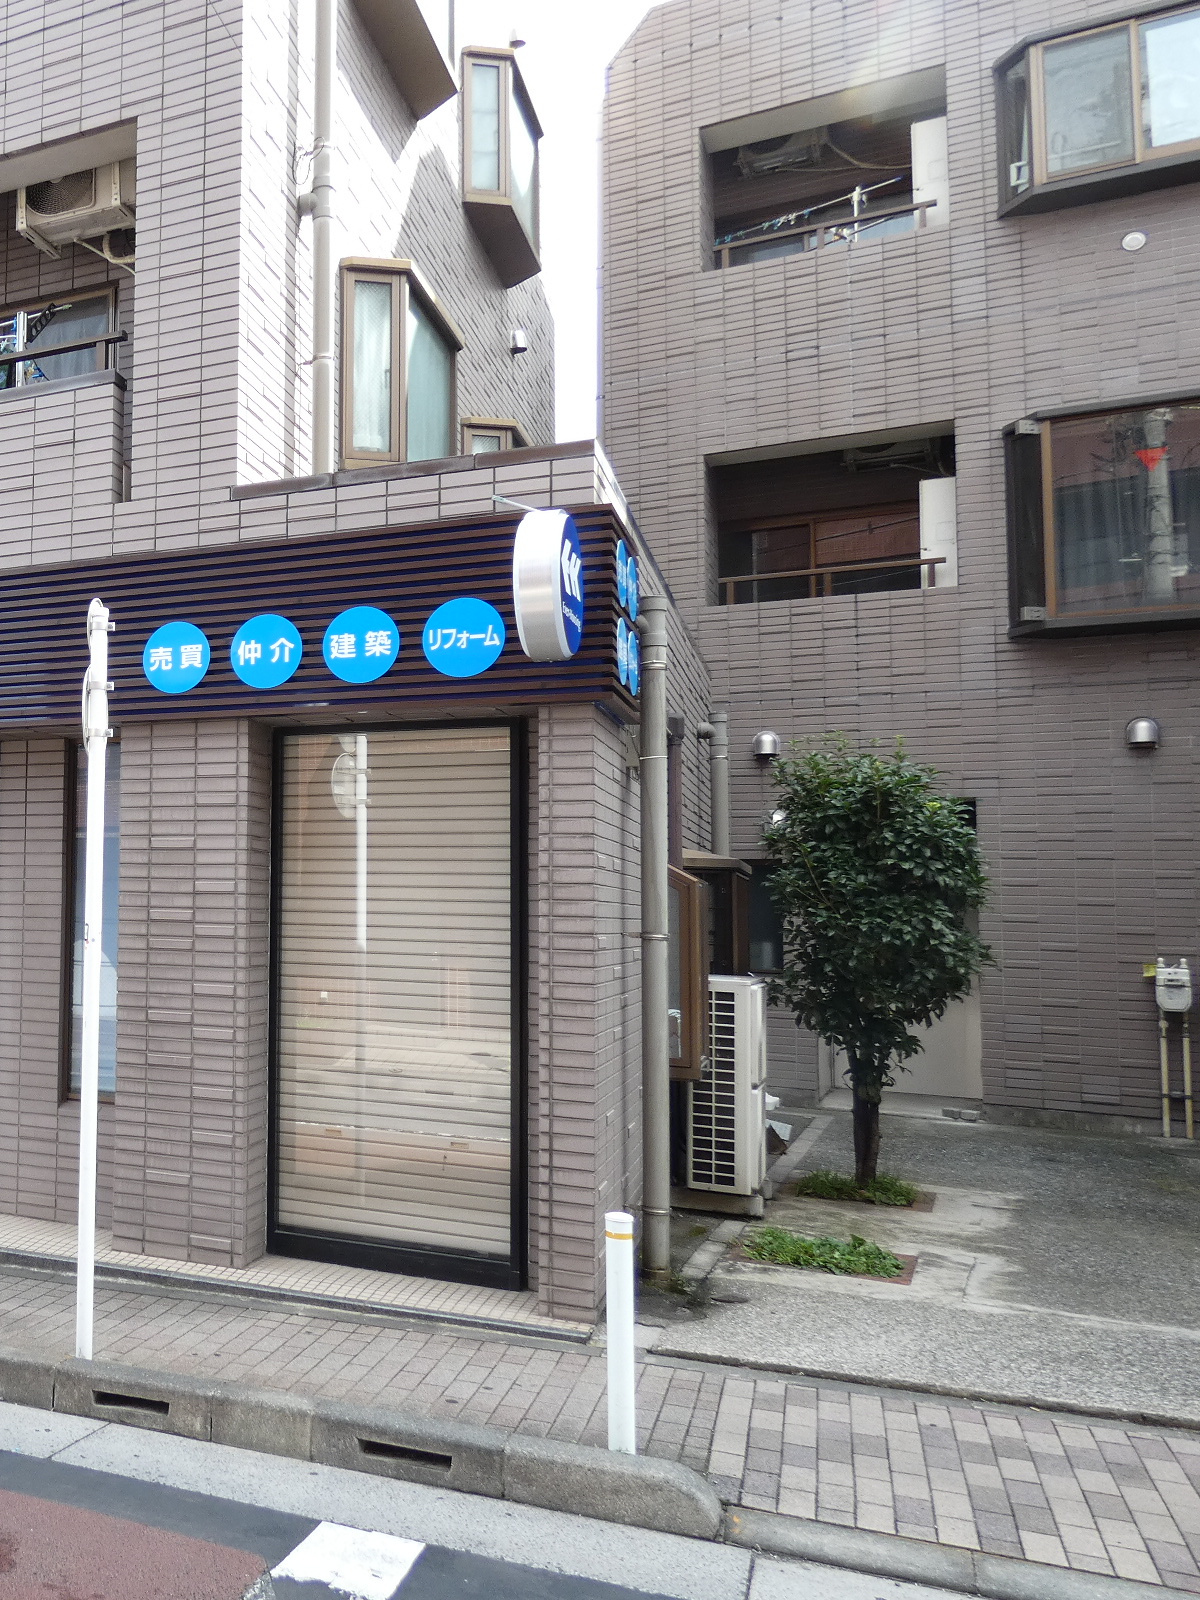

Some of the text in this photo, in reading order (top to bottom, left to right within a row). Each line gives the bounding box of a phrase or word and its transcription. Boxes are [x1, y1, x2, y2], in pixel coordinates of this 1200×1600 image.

[330, 631, 392, 659] 建築
[428, 624, 500, 650] リフォーム
[149, 643, 203, 671] 売買
[238, 637, 295, 666] 仲介
